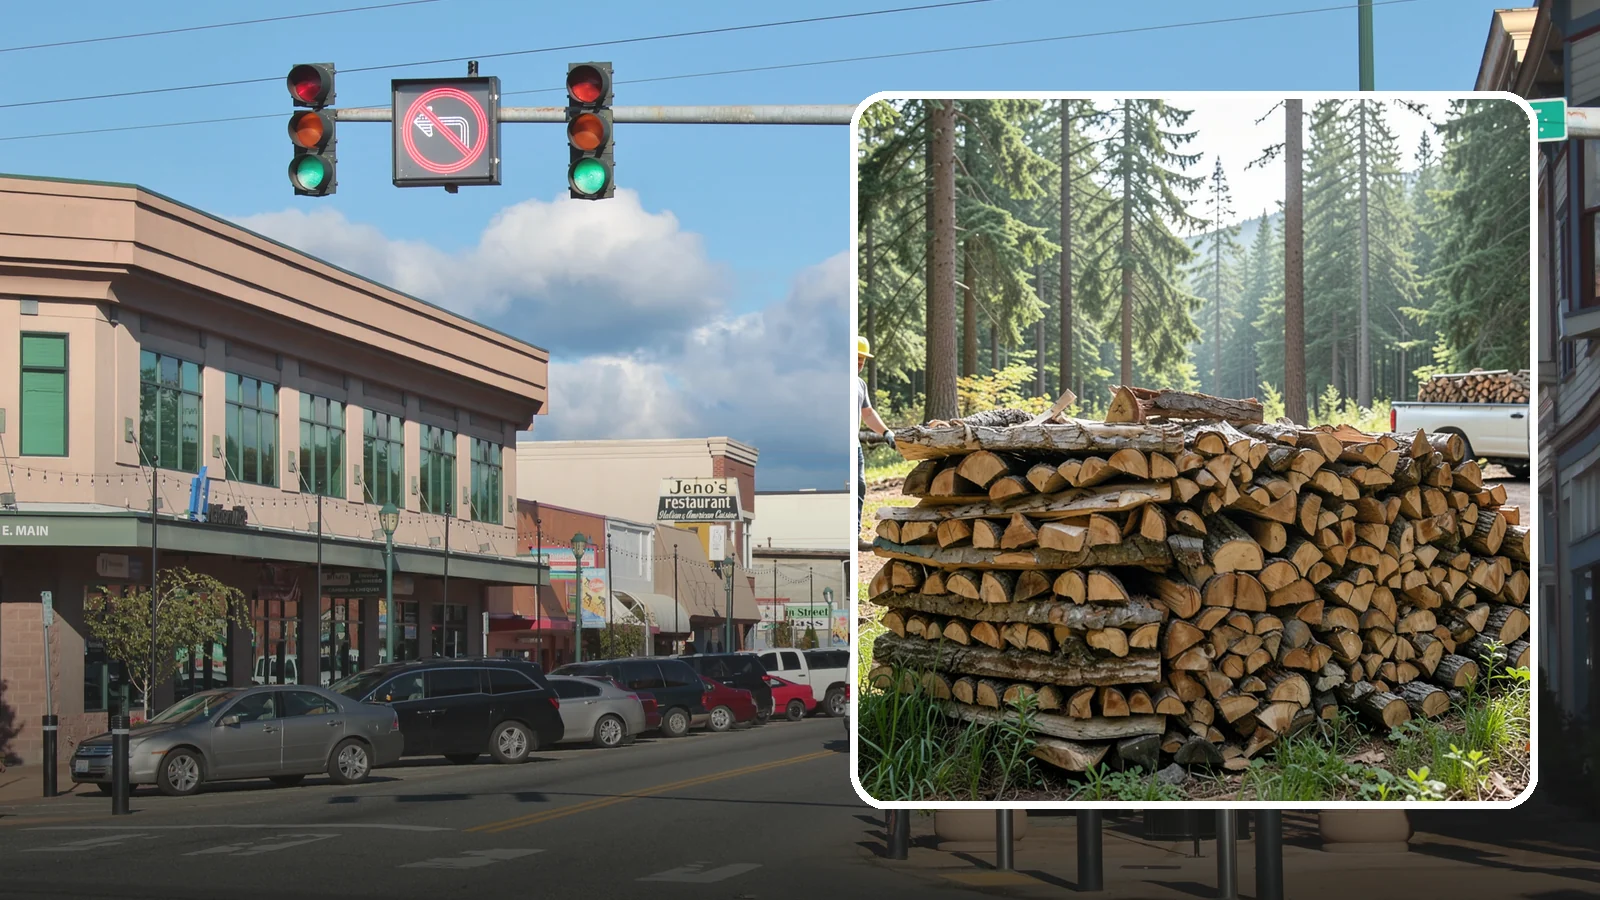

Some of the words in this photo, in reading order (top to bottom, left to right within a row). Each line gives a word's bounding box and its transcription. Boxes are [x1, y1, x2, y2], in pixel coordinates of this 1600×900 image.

[670, 480, 727, 495] Jeno's
[665, 496, 730, 509] restaurant
[658, 509, 681, 519] Italian
[686, 509, 714, 519] American
[715, 509, 737, 519] Cuisine
[2, 525, 13, 536] E.
[15, 525, 49, 536] MAIN
[797, 607, 828, 617] Street
[790, 619, 824, 627] lass
